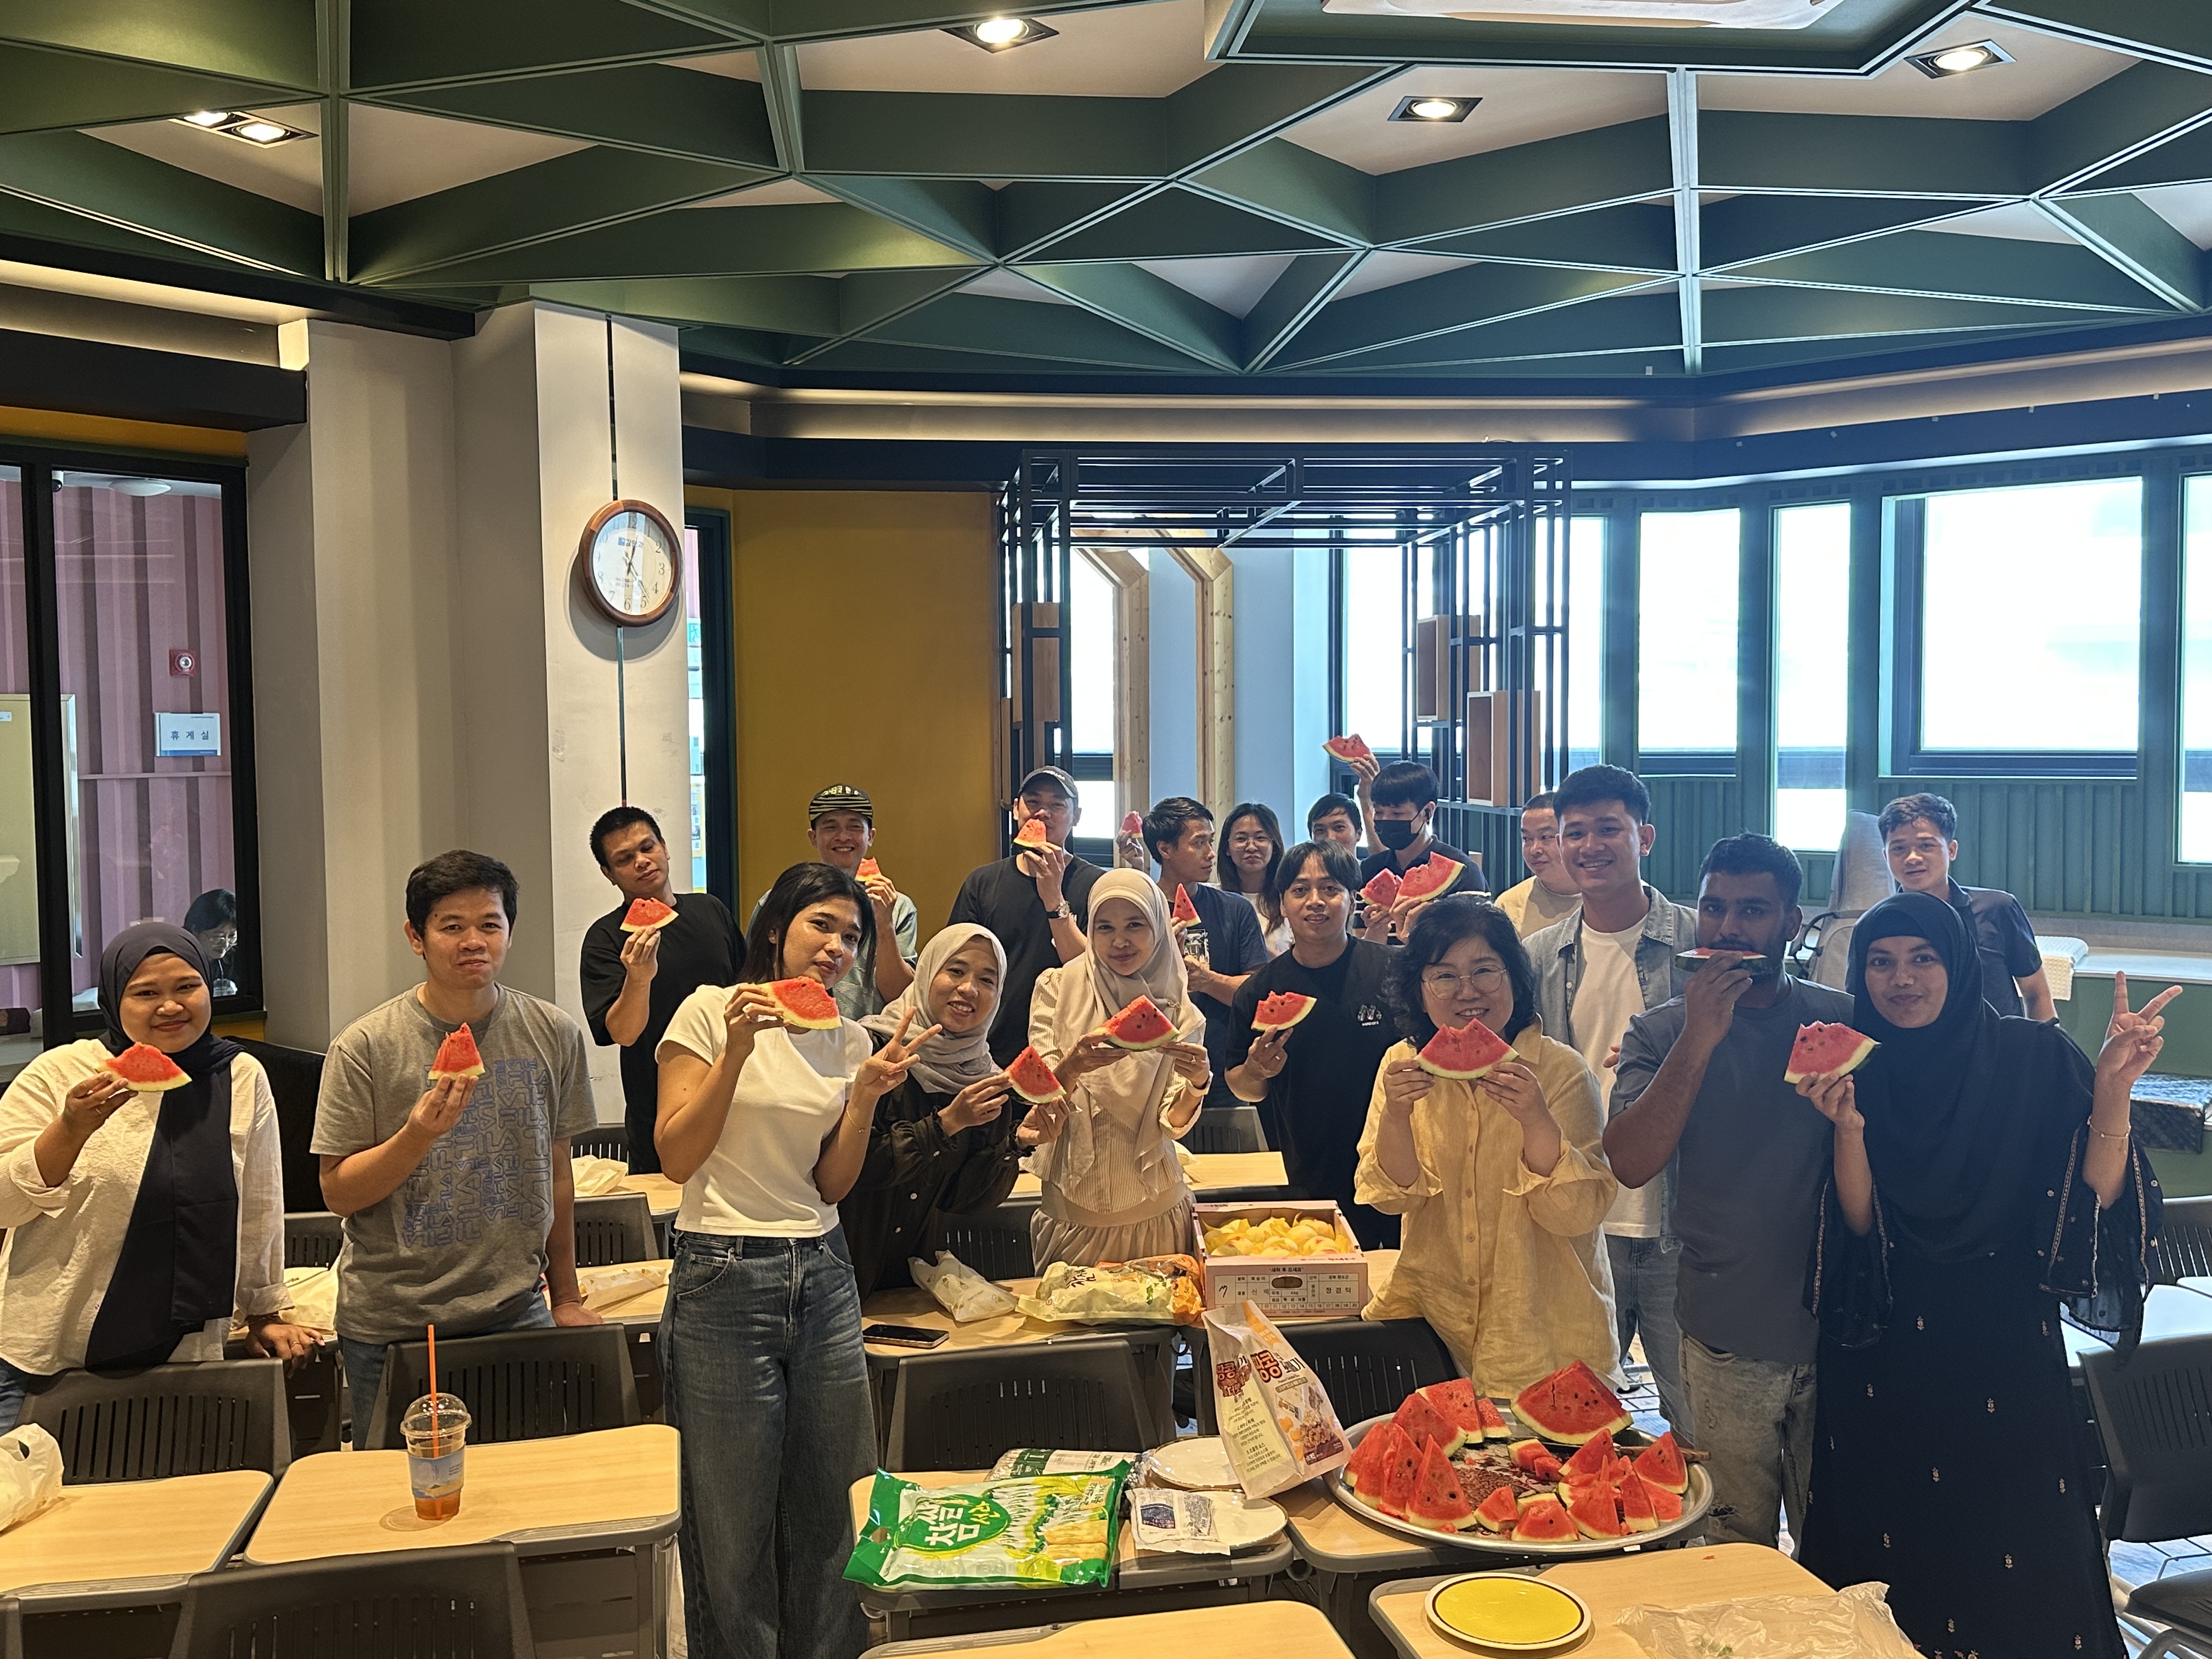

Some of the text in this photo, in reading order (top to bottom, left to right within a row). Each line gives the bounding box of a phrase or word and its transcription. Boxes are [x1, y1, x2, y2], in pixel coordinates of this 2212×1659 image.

[655, 540, 662, 554] 2
[594, 551, 601, 563] 9
[658, 562, 665, 575] 3
[597, 571, 604, 584] 8
[652, 582, 659, 594] 4
[608, 590, 616, 602] 7
[640, 596, 647, 608] 5
[624, 597, 631, 611] 6
[171, 730, 209, 740] 휴게실
[507, 1069, 551, 1087] FILA
[498, 1106, 548, 1128] FILA
[454, 1128, 521, 1159] FILA
[521, 1127, 550, 1226] FILA
[455, 1172, 482, 1242] FILA
